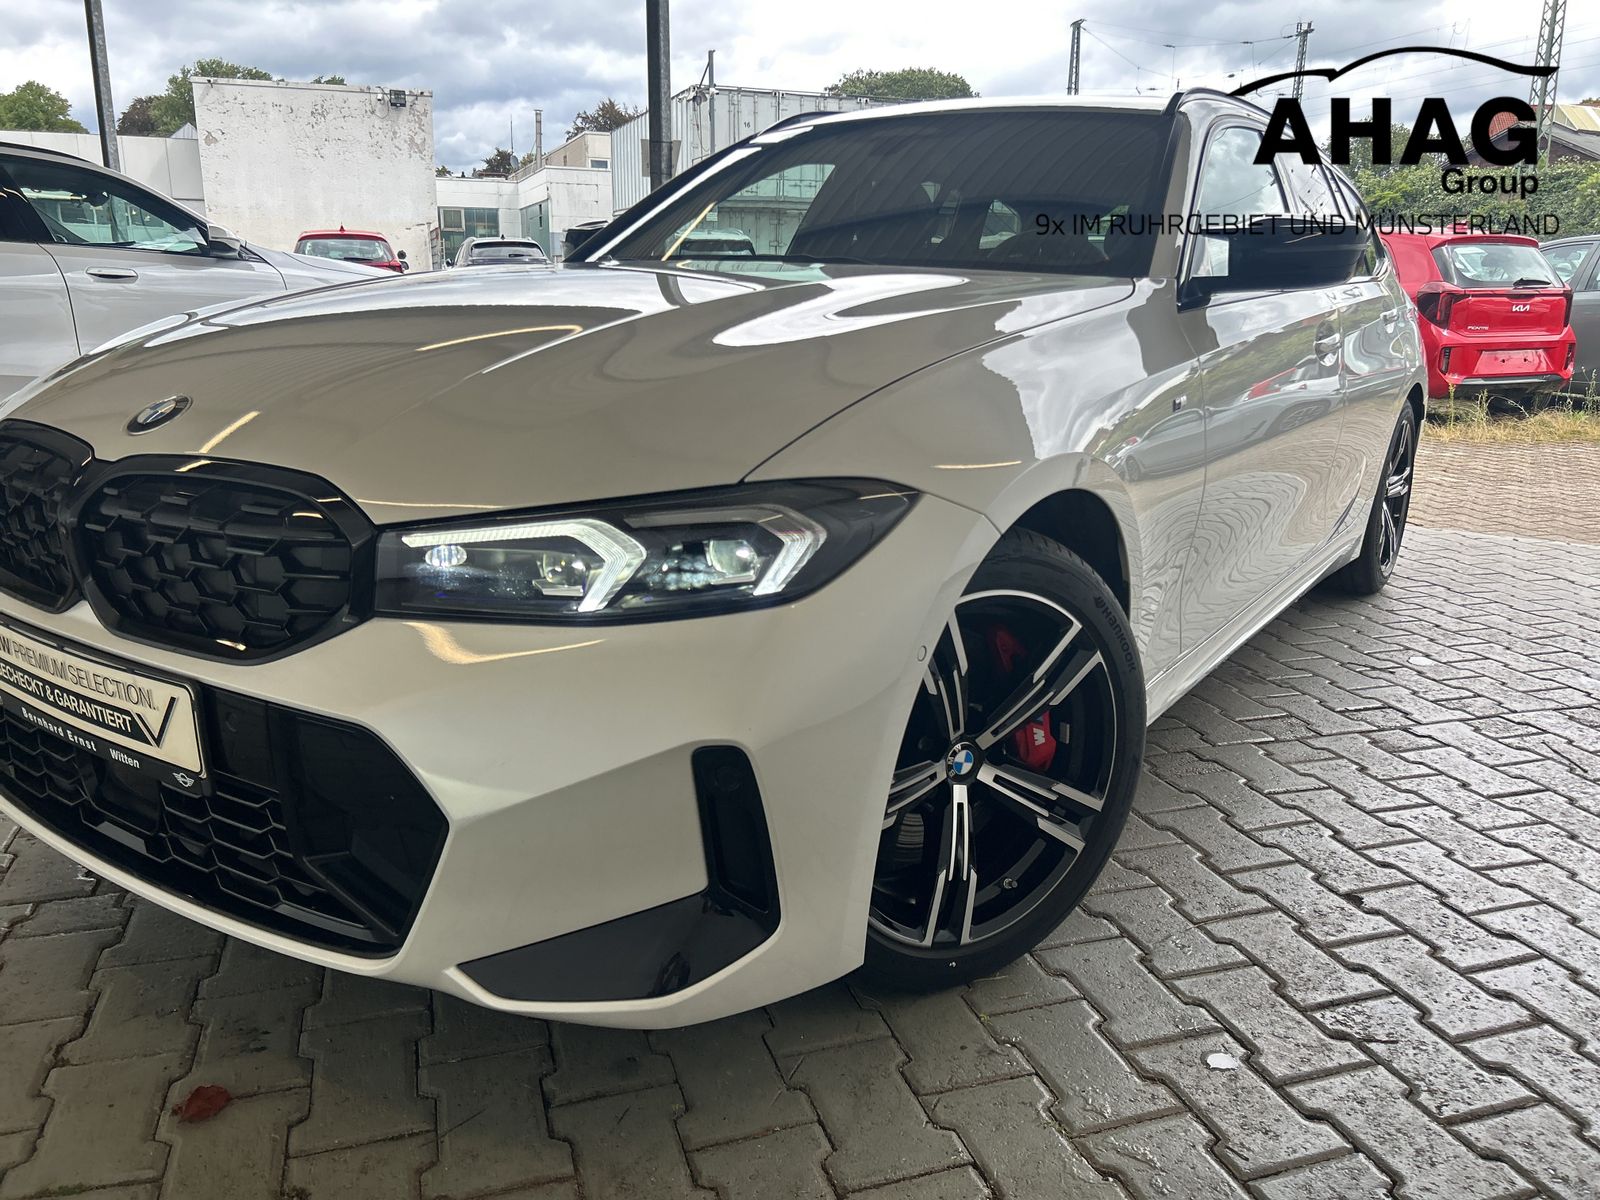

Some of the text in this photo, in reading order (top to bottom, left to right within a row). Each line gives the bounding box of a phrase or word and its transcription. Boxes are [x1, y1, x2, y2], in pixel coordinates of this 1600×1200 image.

[12, 641, 67, 680] PREMIUM
[45, 685, 55, 702] &
[54, 689, 132, 733] GARANTIERT
[21, 707, 140, 769] Bernhard Ernst Witten
